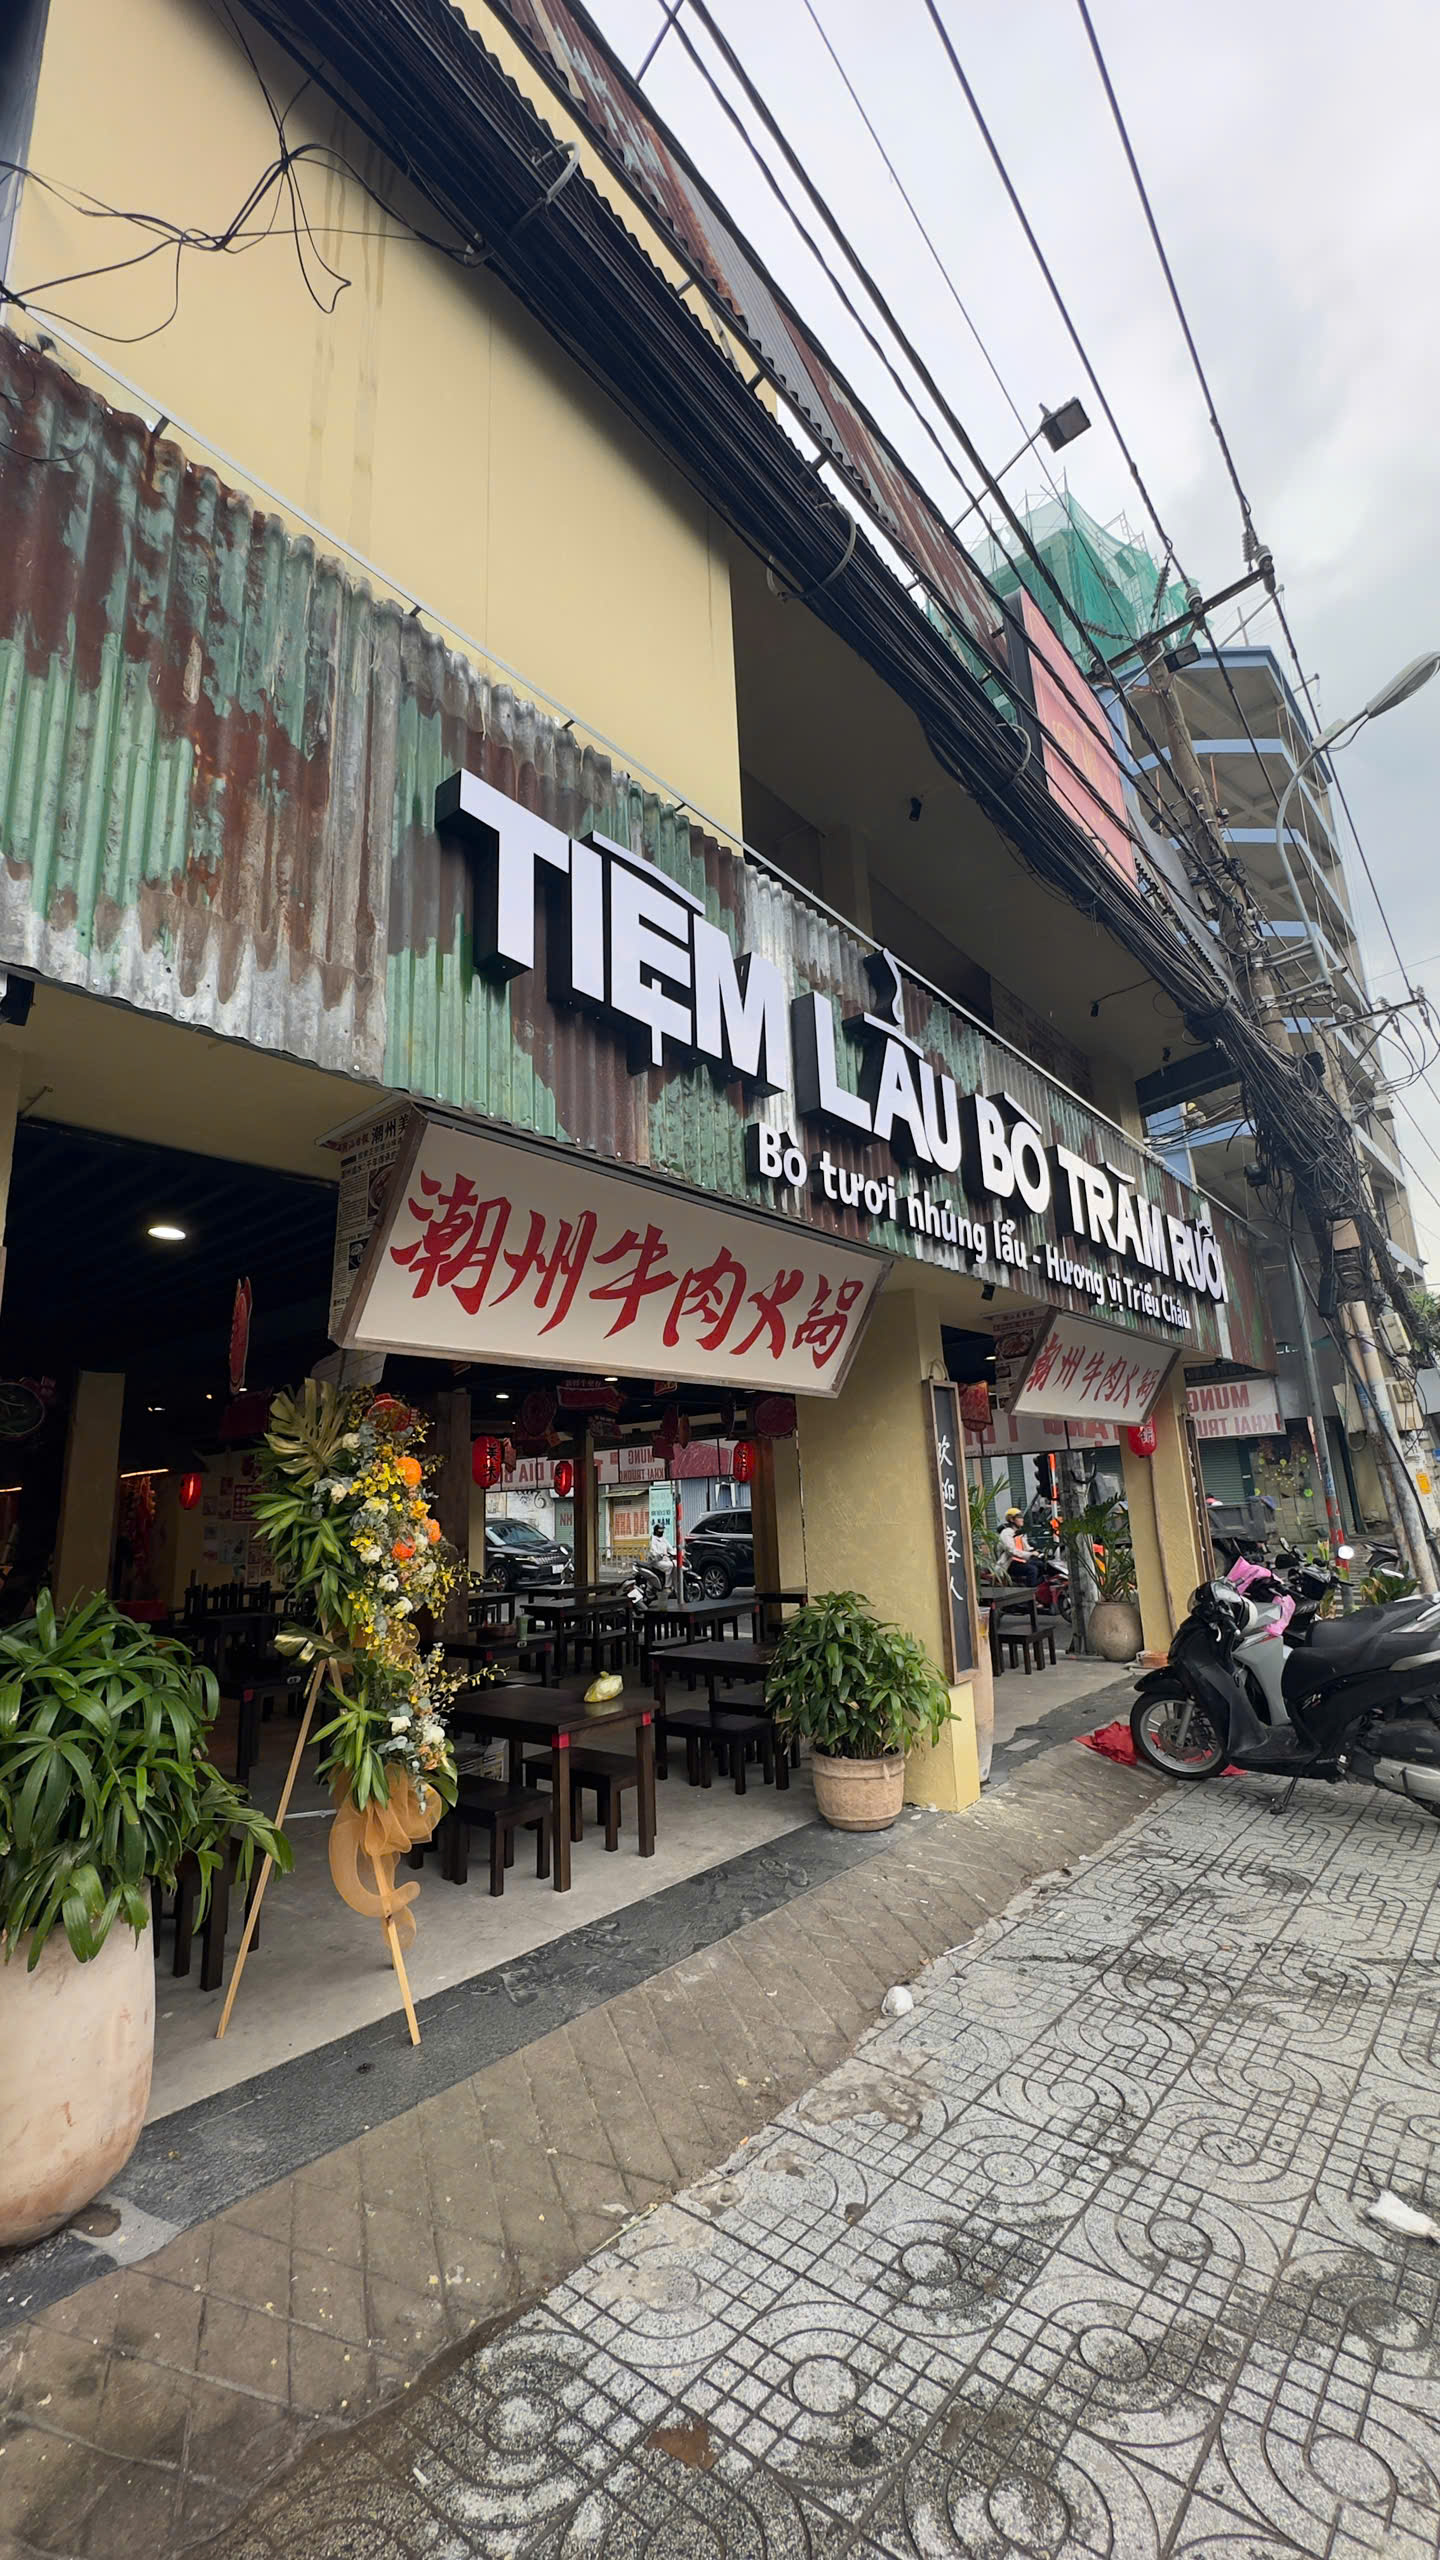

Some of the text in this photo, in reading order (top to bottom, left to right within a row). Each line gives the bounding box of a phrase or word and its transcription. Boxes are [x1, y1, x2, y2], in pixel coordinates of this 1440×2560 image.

[460, 768, 787, 1092] TIỆM
[814, 948, 962, 1172] LẨU
[975, 1091, 1051, 1214] BÒ
[1057, 1144, 1170, 1277] TRĂM
[759, 1122, 808, 1187] Bò
[819, 1150, 897, 1220] tươi
[907, 1190, 987, 1264] nhúng
[994, 1219, 1029, 1271] lẩu
[1045, 1243, 1105, 1305] Hương
[1107, 1273, 1124, 1312] vị
[1161, 1294, 1192, 1329] Châu
